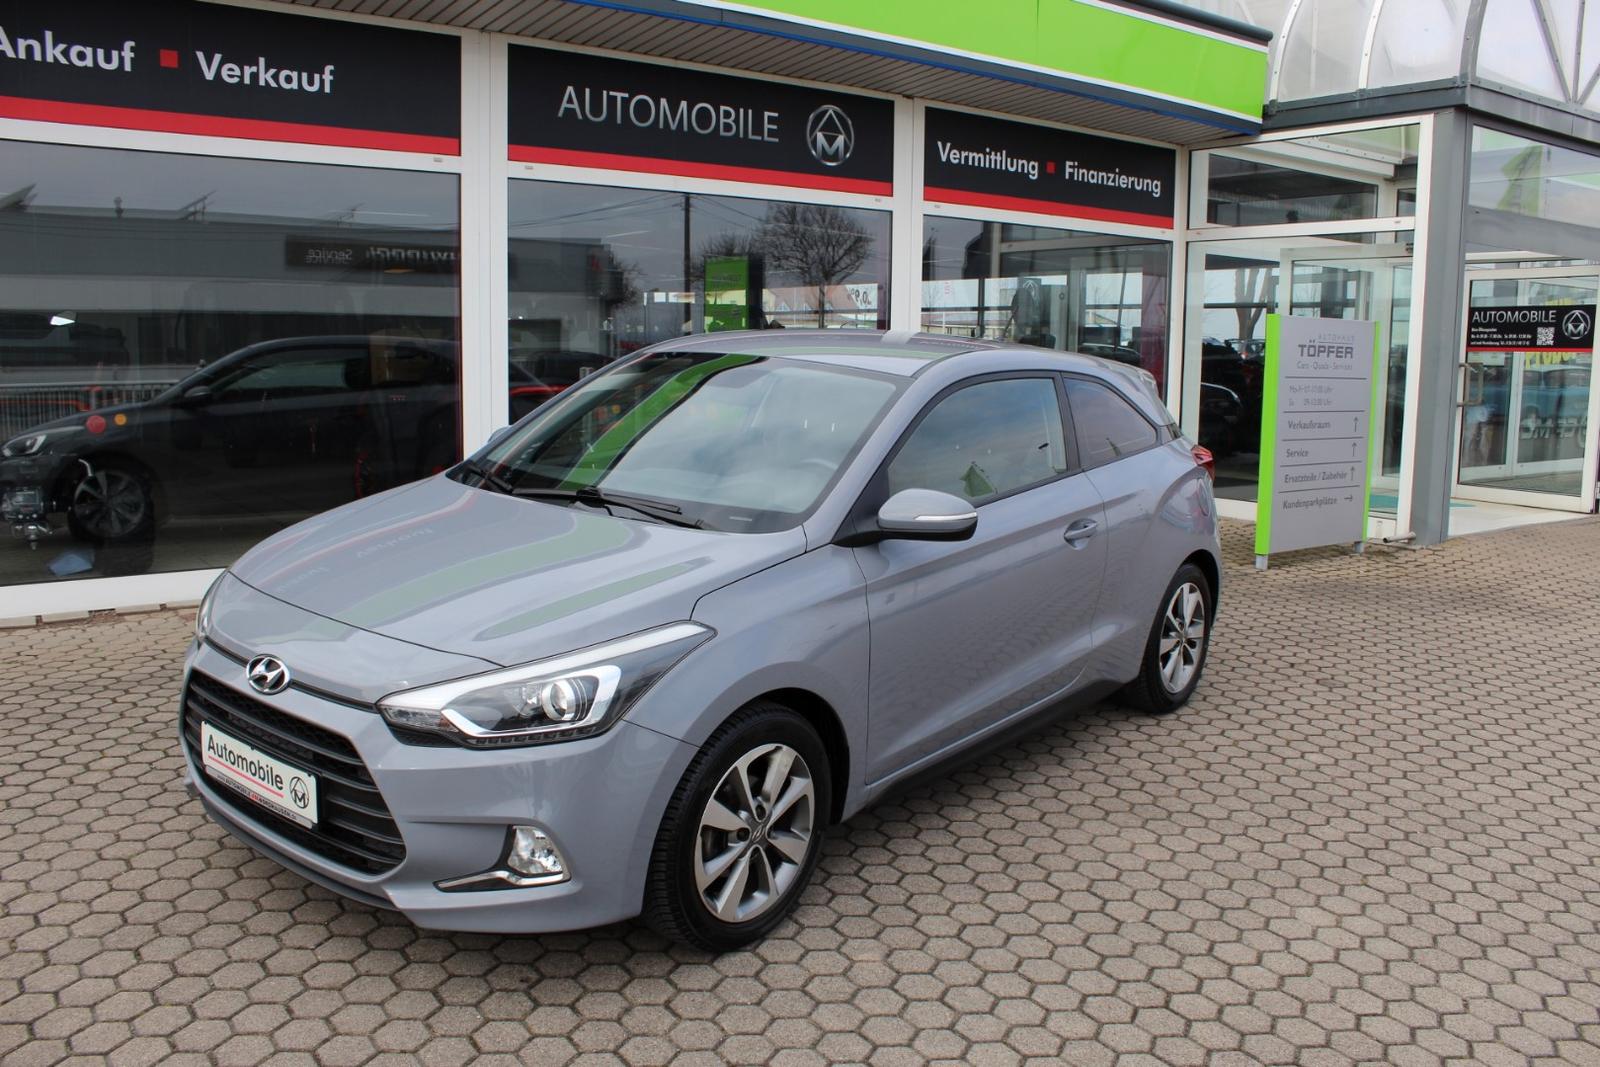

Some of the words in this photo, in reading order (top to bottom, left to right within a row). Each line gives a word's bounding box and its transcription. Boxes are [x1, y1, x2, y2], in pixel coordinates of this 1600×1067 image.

[0, 25, 136, 72] Ankauf
[195, 50, 335, 93] Verkauf
[558, 85, 779, 143] AUTOMOBILE
[937, 141, 1038, 180] Vermittlung
[1065, 161, 1161, 198] Finanzierung
[1472, 310, 1557, 323] AUTOMOBILE
[1298, 339, 1354, 359] TÖPFER
[1286, 448, 1309, 458] Service
[207, 734, 284, 791] Automobile
